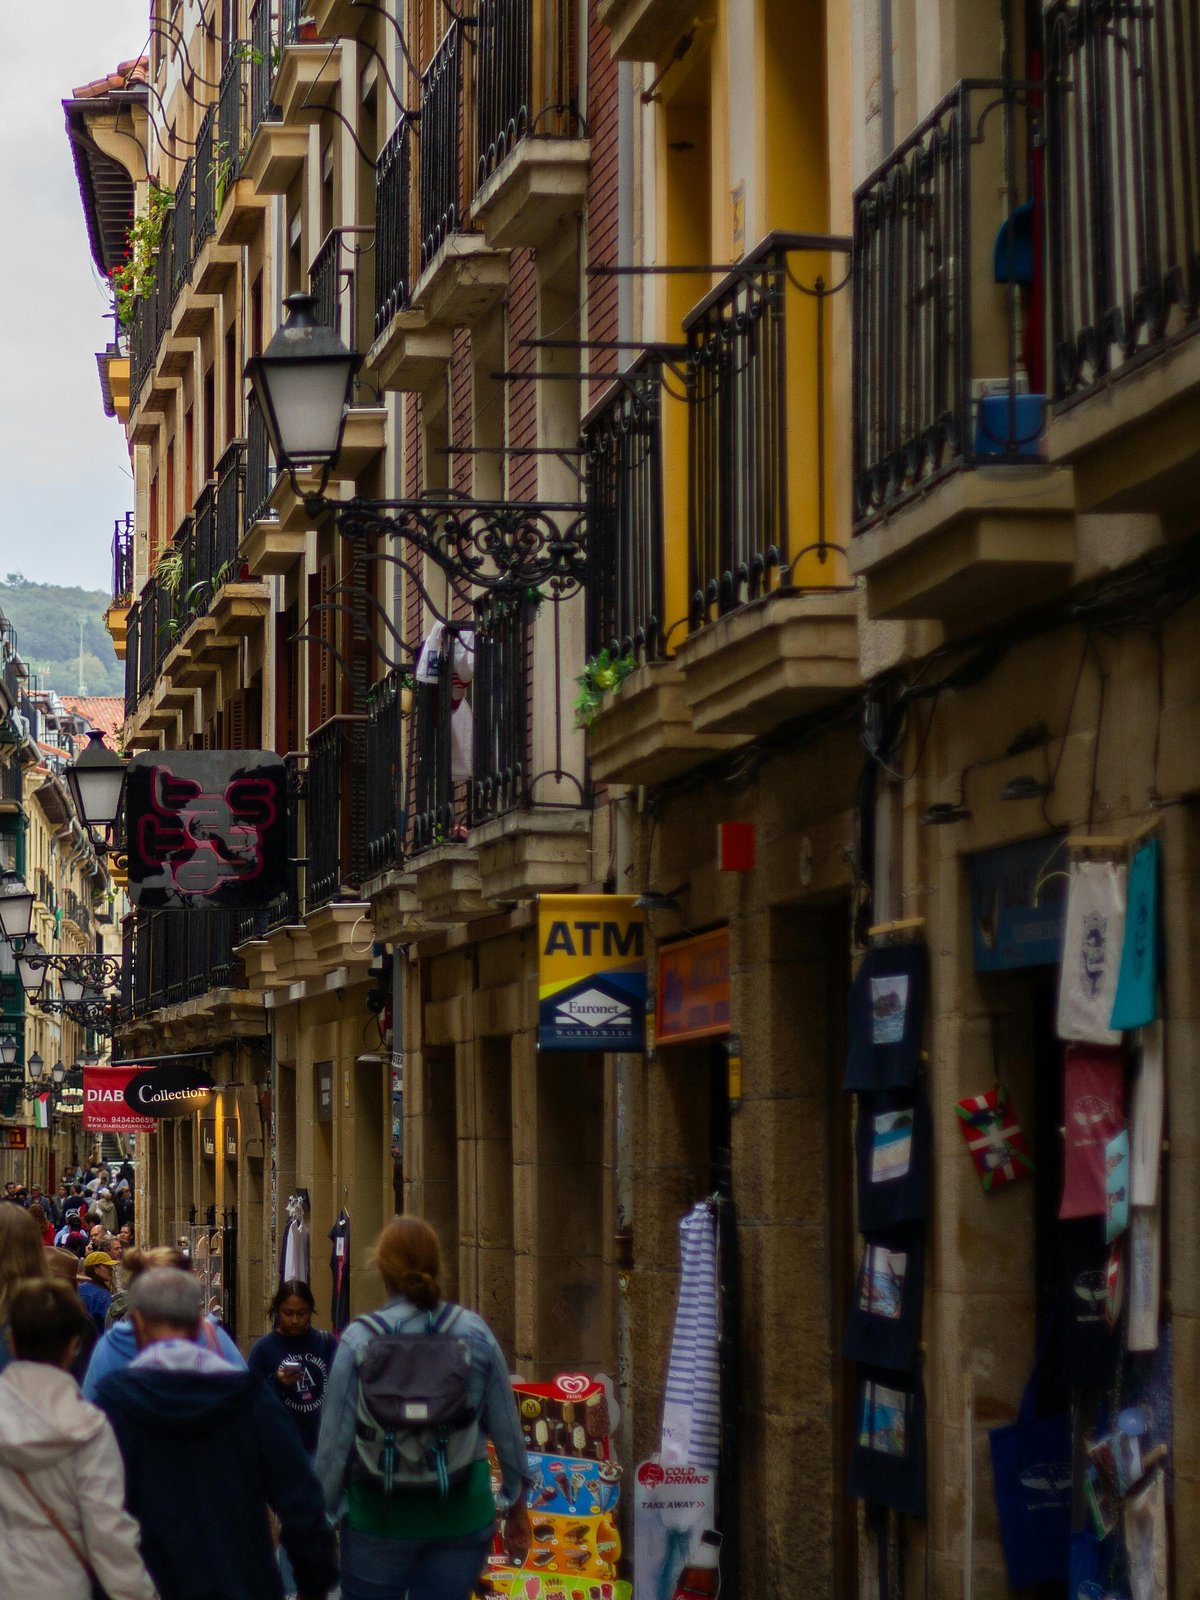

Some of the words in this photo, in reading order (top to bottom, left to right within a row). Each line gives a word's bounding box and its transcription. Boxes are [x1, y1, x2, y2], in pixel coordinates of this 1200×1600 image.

[544, 921, 644, 956] ATM
[569, 1001, 619, 1014] Euronet
[87, 1089, 125, 1102] DIAB
[138, 1085, 207, 1104] Collection
[665, 1467, 696, 1476] COLD
[664, 1475, 710, 1485] DRINKS
[666, 1501, 695, 1509] AWAY
